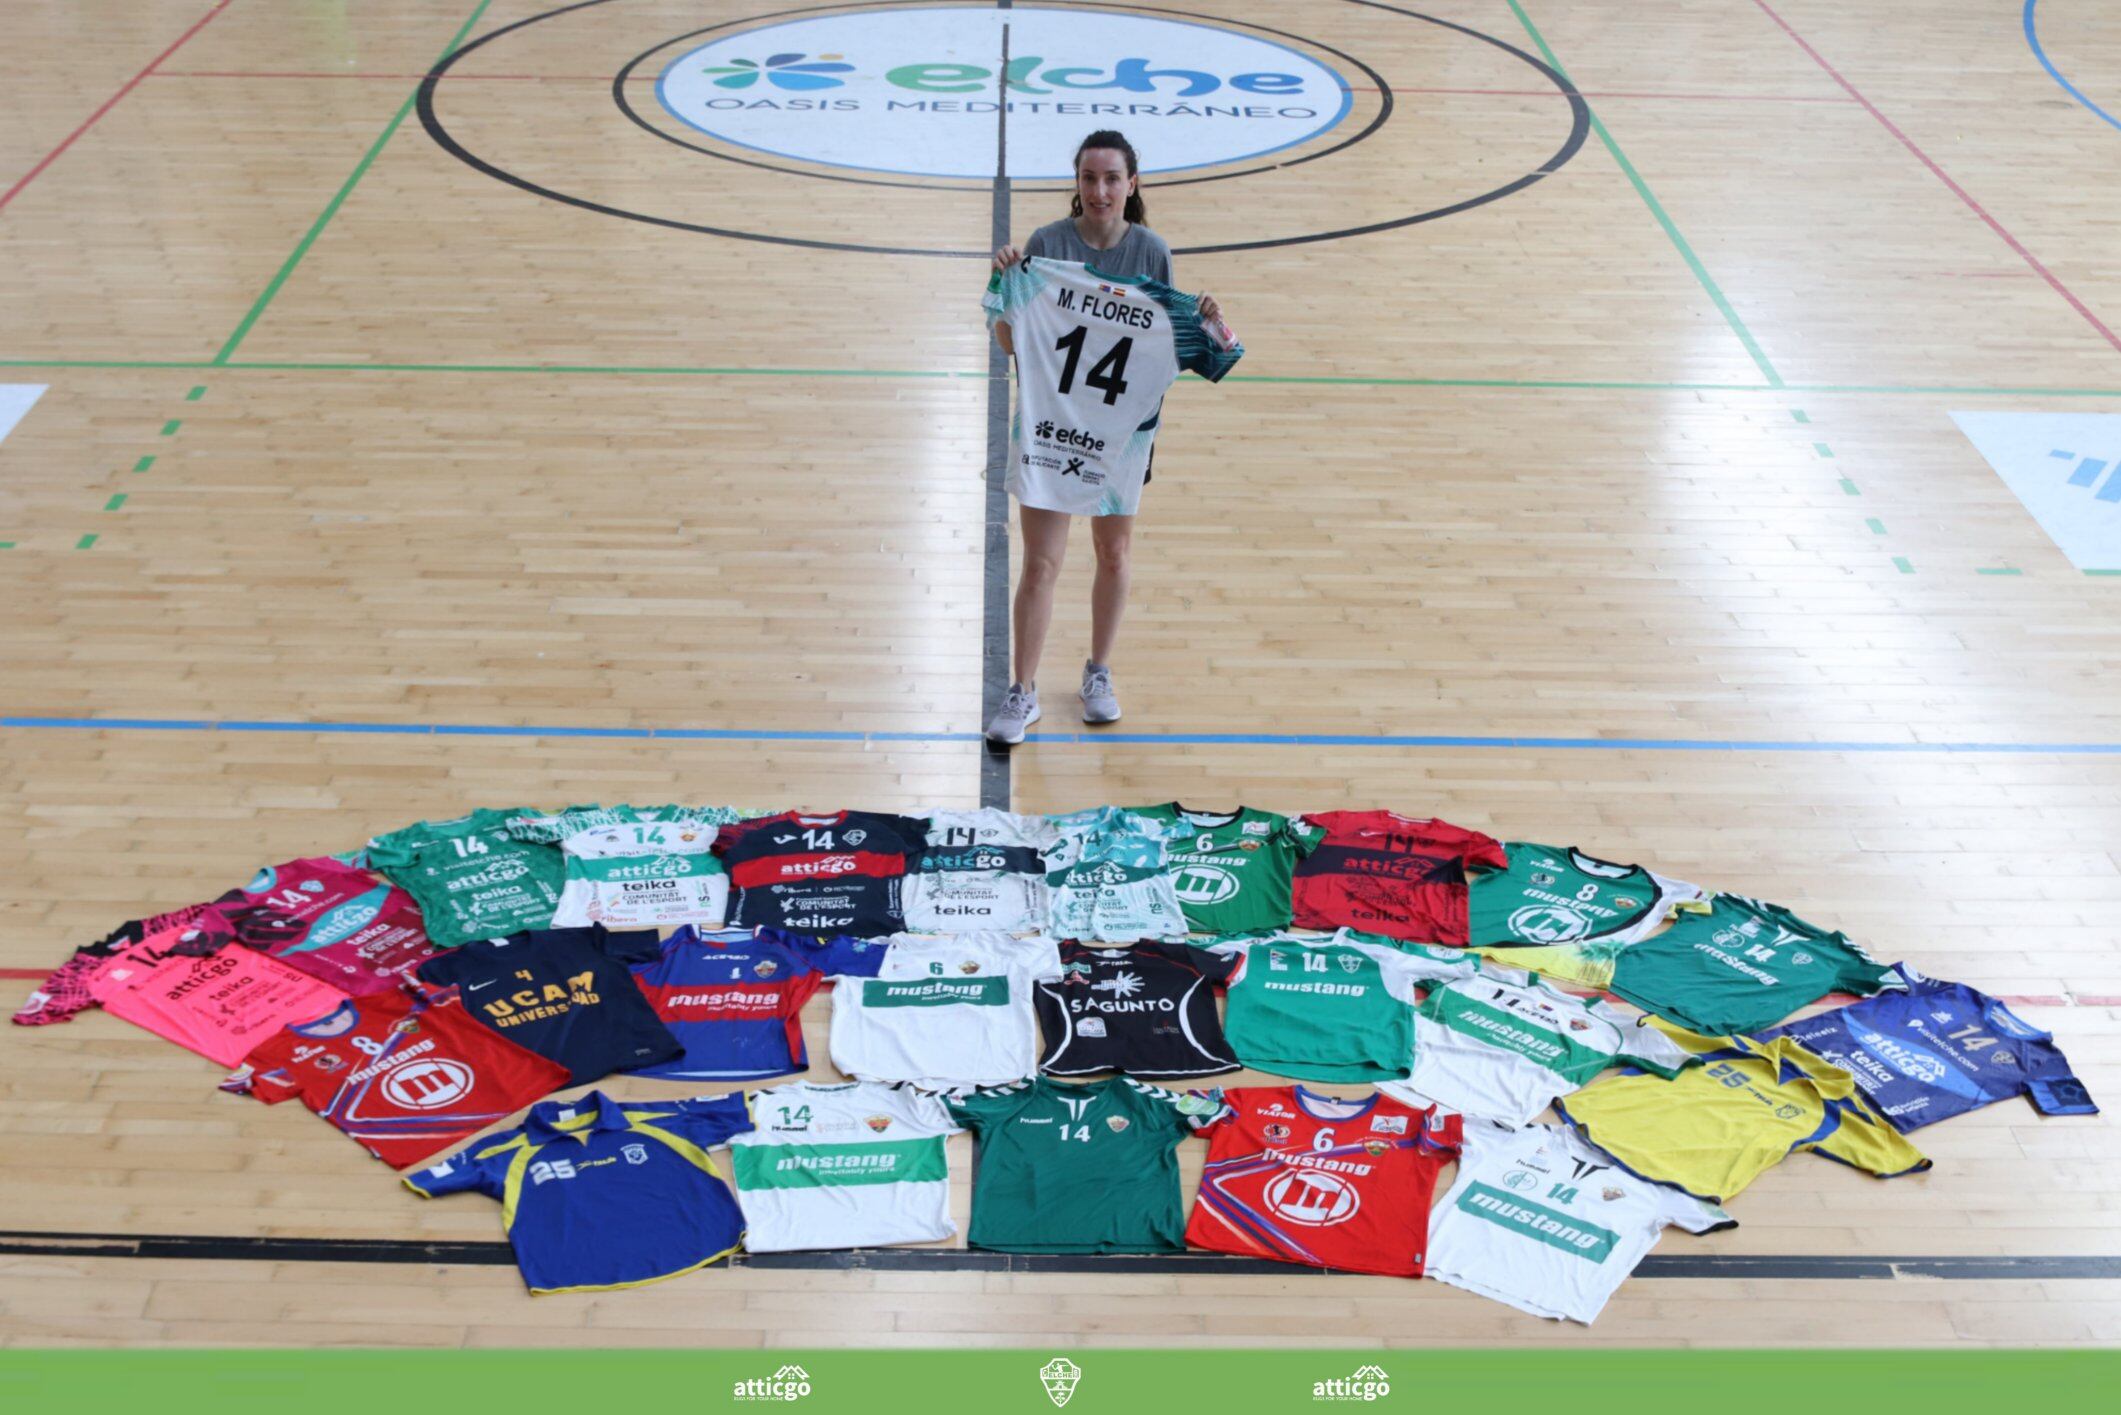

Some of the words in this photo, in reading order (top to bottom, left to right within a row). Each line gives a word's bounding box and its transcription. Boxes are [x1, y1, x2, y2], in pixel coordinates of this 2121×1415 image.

[886, 56, 1304, 97] elche
[705, 98, 860, 112] OASIS
[1057, 288, 1076, 311] M.
[1081, 295, 1154, 329] FLORES
[1055, 325, 1133, 406] 14
[1056, 428, 1105, 451] elche
[633, 826, 666, 845] 14
[802, 829, 835, 850] 14
[947, 828, 976, 846] 14
[1073, 830, 1102, 846] 14
[1196, 833, 1213, 851] 6
[449, 836, 489, 858] 14
[608, 862, 692, 878] atticgo
[781, 859, 856, 874] atticgo
[921, 855, 1006, 869] atticgo
[447, 866, 529, 889] atticgo
[622, 880, 676, 891] teika
[266, 889, 312, 909] 14
[472, 885, 522, 900] teika
[1576, 883, 1599, 901] 8
[934, 905, 991, 915] teika
[783, 914, 854, 928] teika
[1302, 952, 1328, 973] 14
[1744, 944, 1776, 962] 14
[930, 961, 943, 975] 6
[1694, 943, 1780, 986] mustang
[166, 957, 238, 1001] atticgo
[515, 969, 533, 981] 4
[209, 976, 254, 1001] teika
[483, 971, 594, 1017] UCAM
[887, 982, 983, 996] mustang
[1264, 980, 1365, 997] mustang
[667, 991, 780, 1007] mustang
[1071, 997, 1175, 1013] SAGUNTO
[1457, 1010, 1564, 1057] mustang
[1948, 1024, 1998, 1051] 14
[351, 1036, 384, 1055] 8
[347, 1037, 435, 1085] mustang
[1850, 1050, 1894, 1082] teika
[1859, 1032, 1936, 1083] atticgo
[777, 1105, 814, 1125] 14
[1059, 1123, 1091, 1142] 14
[1313, 1127, 1336, 1152] 6
[776, 1153, 897, 1171] mustang
[1262, 1147, 1372, 1176] mustang
[1547, 1182, 1579, 1205] 14
[1469, 1192, 1600, 1249] mustang
